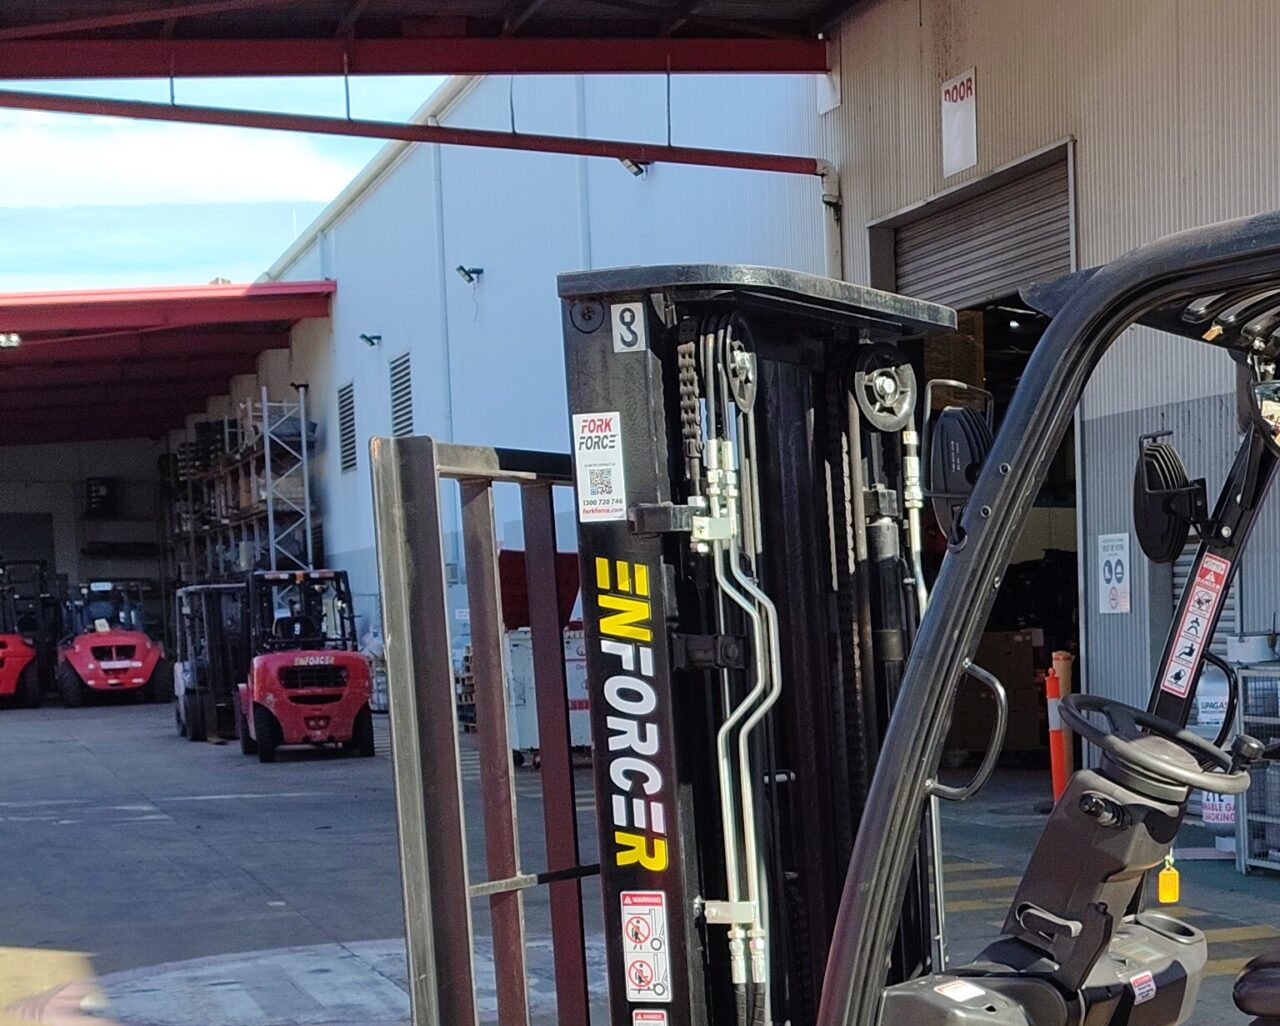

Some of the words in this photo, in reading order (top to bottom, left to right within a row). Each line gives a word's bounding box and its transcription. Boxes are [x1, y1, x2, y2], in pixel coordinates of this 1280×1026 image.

[581, 418, 612, 434] FORK
[579, 434, 617, 451] FORCE
[293, 656, 334, 666] ENFORCER
[595, 556, 668, 873] ENFORCER
[632, 895, 662, 904] WARNING
